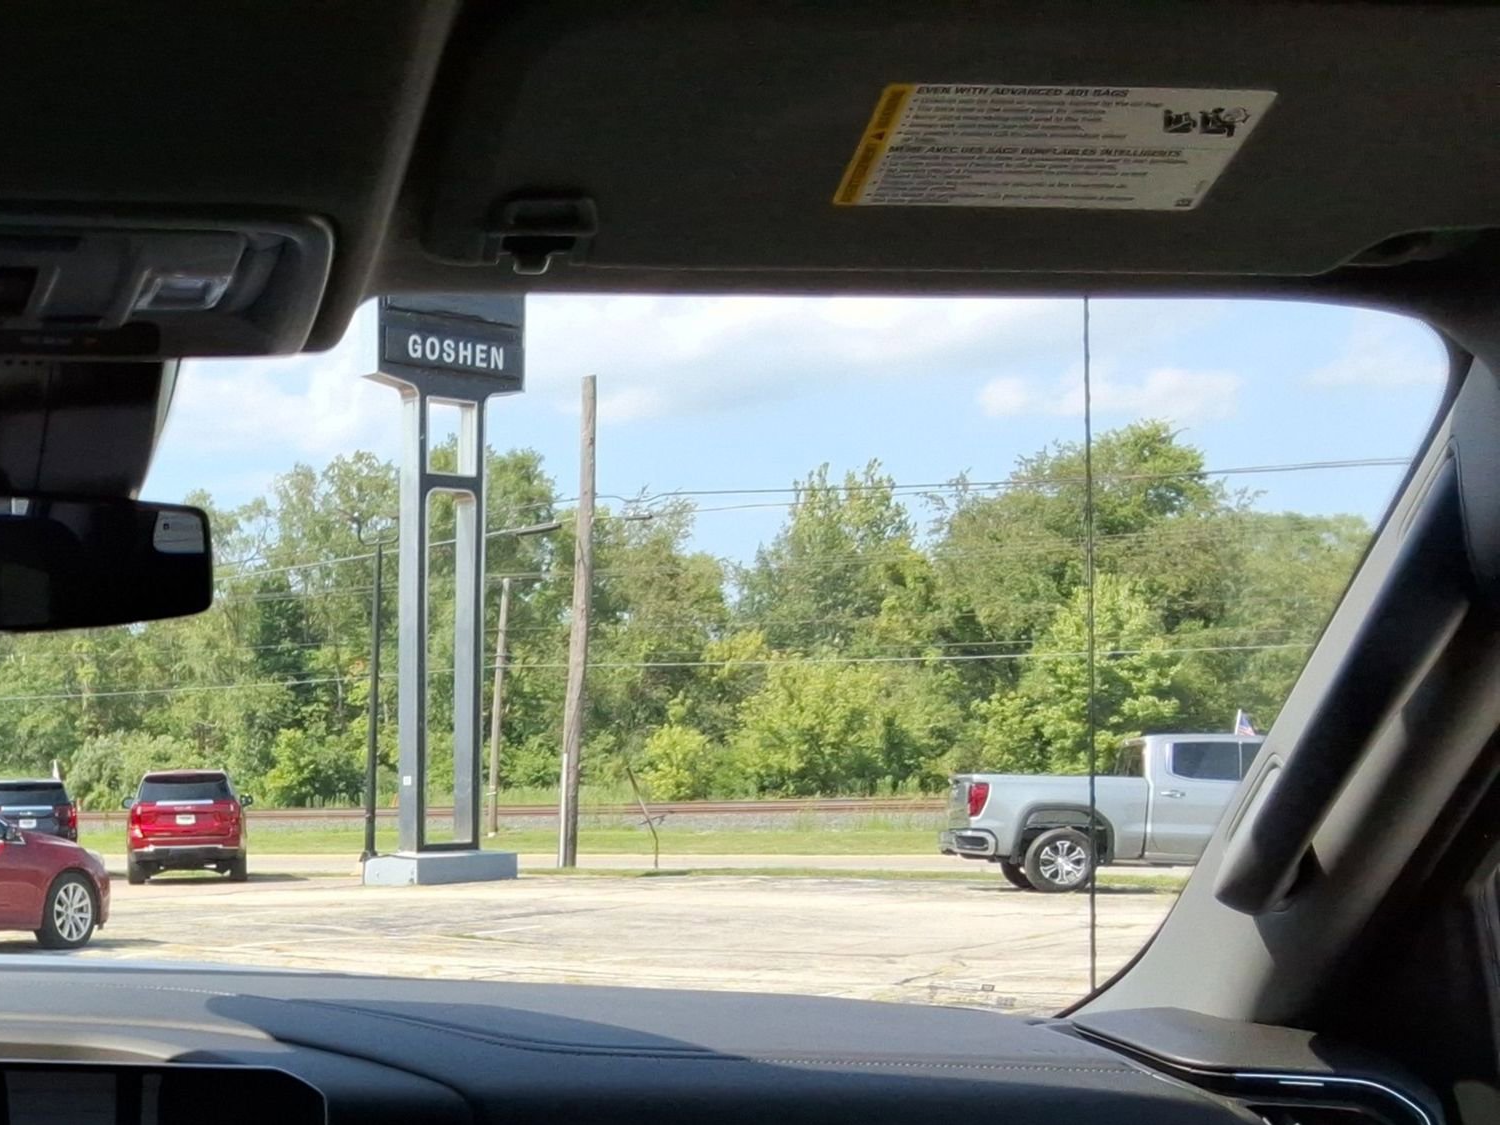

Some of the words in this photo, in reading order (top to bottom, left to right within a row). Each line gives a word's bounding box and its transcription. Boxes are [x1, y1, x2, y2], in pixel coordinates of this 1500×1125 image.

[916, 86, 950, 95] EVEN
[955, 87, 989, 95] WITH
[991, 87, 1062, 97] ADVANCED
[407, 333, 505, 371] GOSHEN
